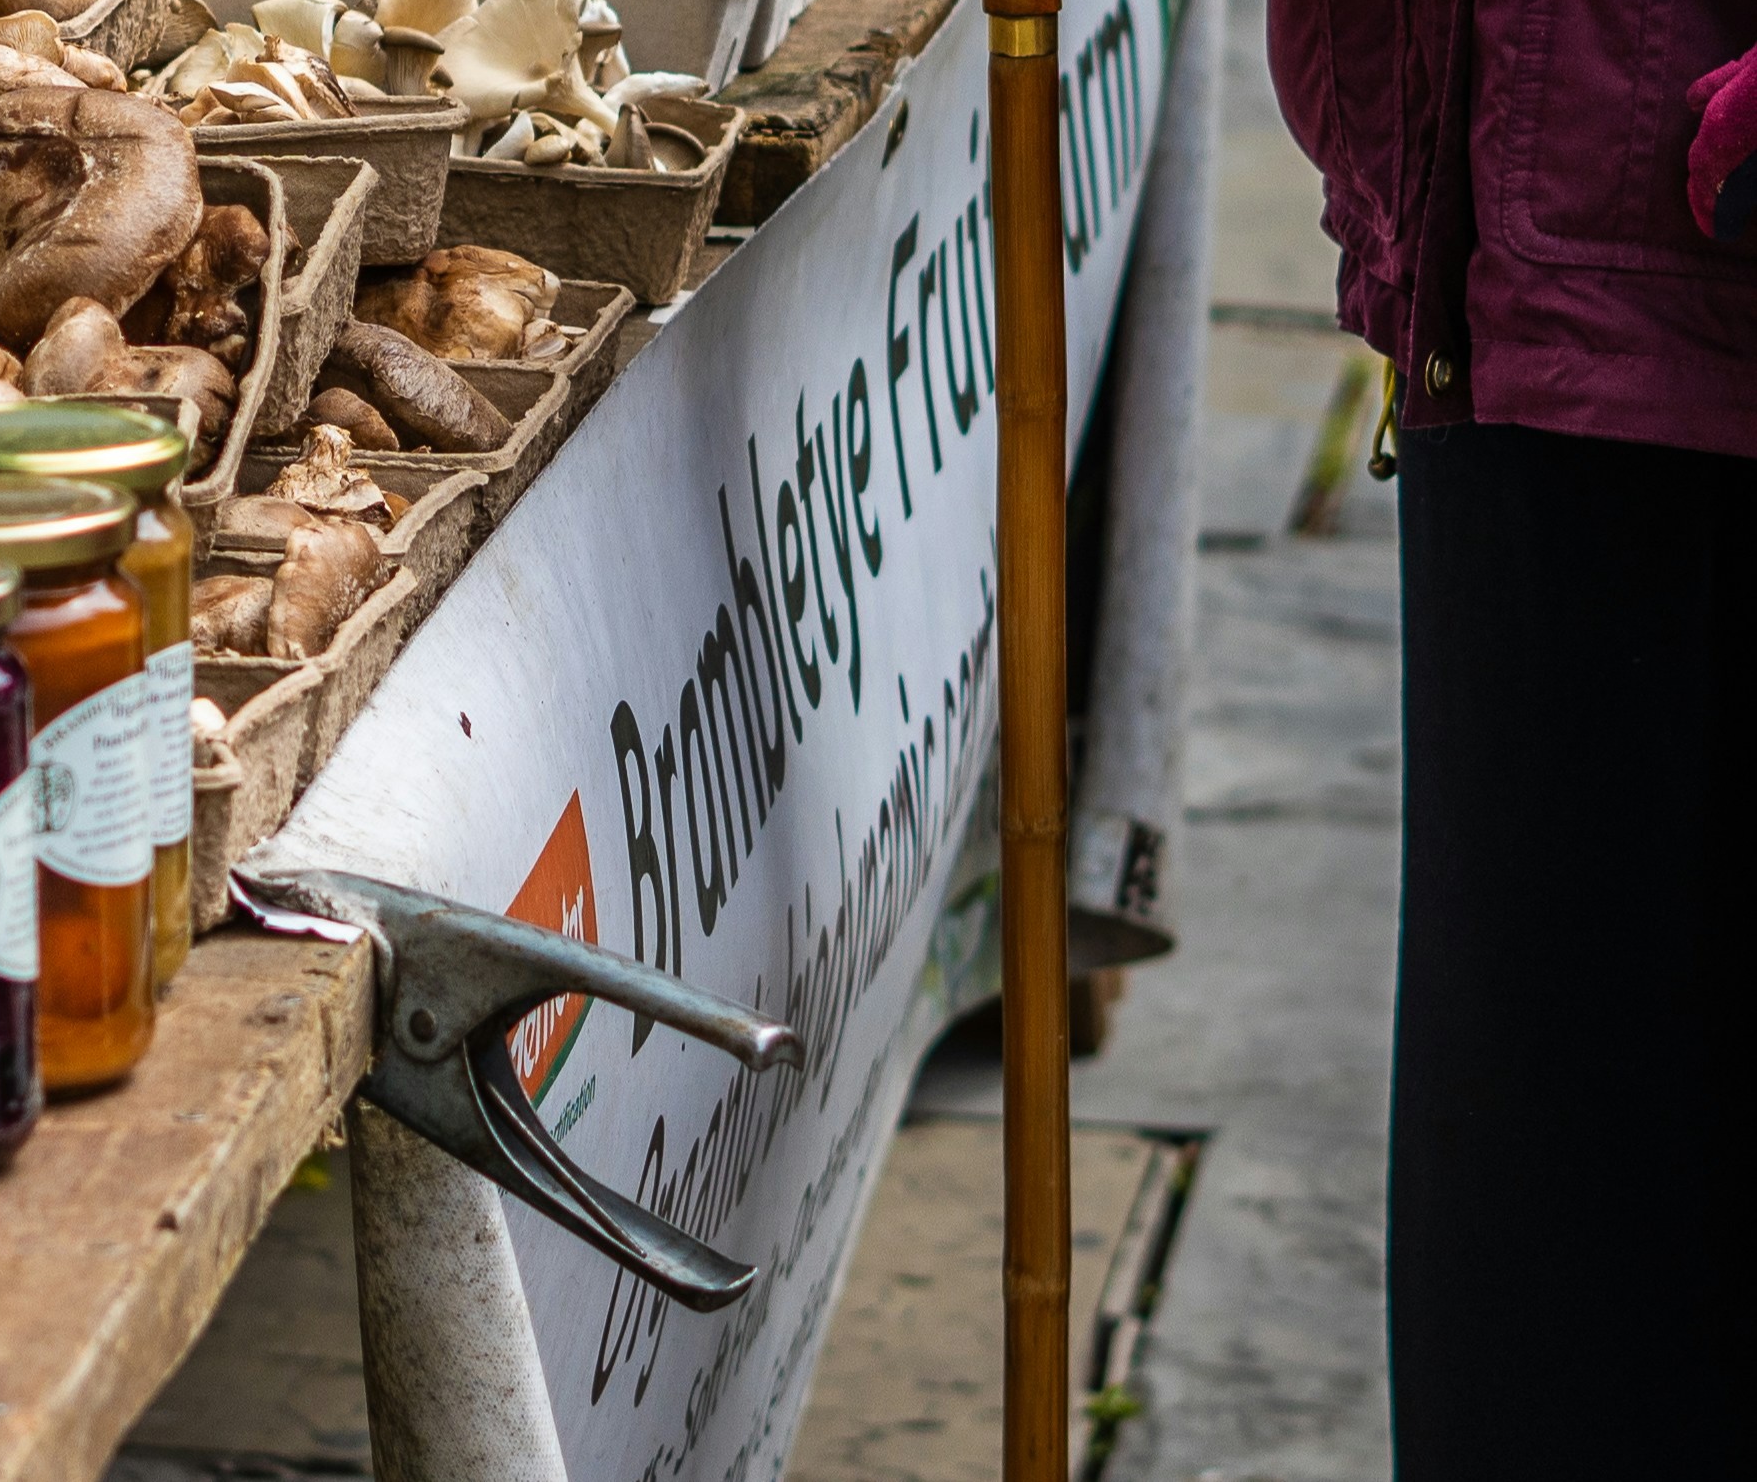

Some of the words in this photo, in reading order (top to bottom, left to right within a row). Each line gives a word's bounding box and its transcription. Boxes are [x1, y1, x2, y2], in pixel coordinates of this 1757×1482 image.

[609, 356, 883, 1059] Brambletye
[888, 106, 995, 521] Frui
[550, 1073, 597, 1144] rtification
